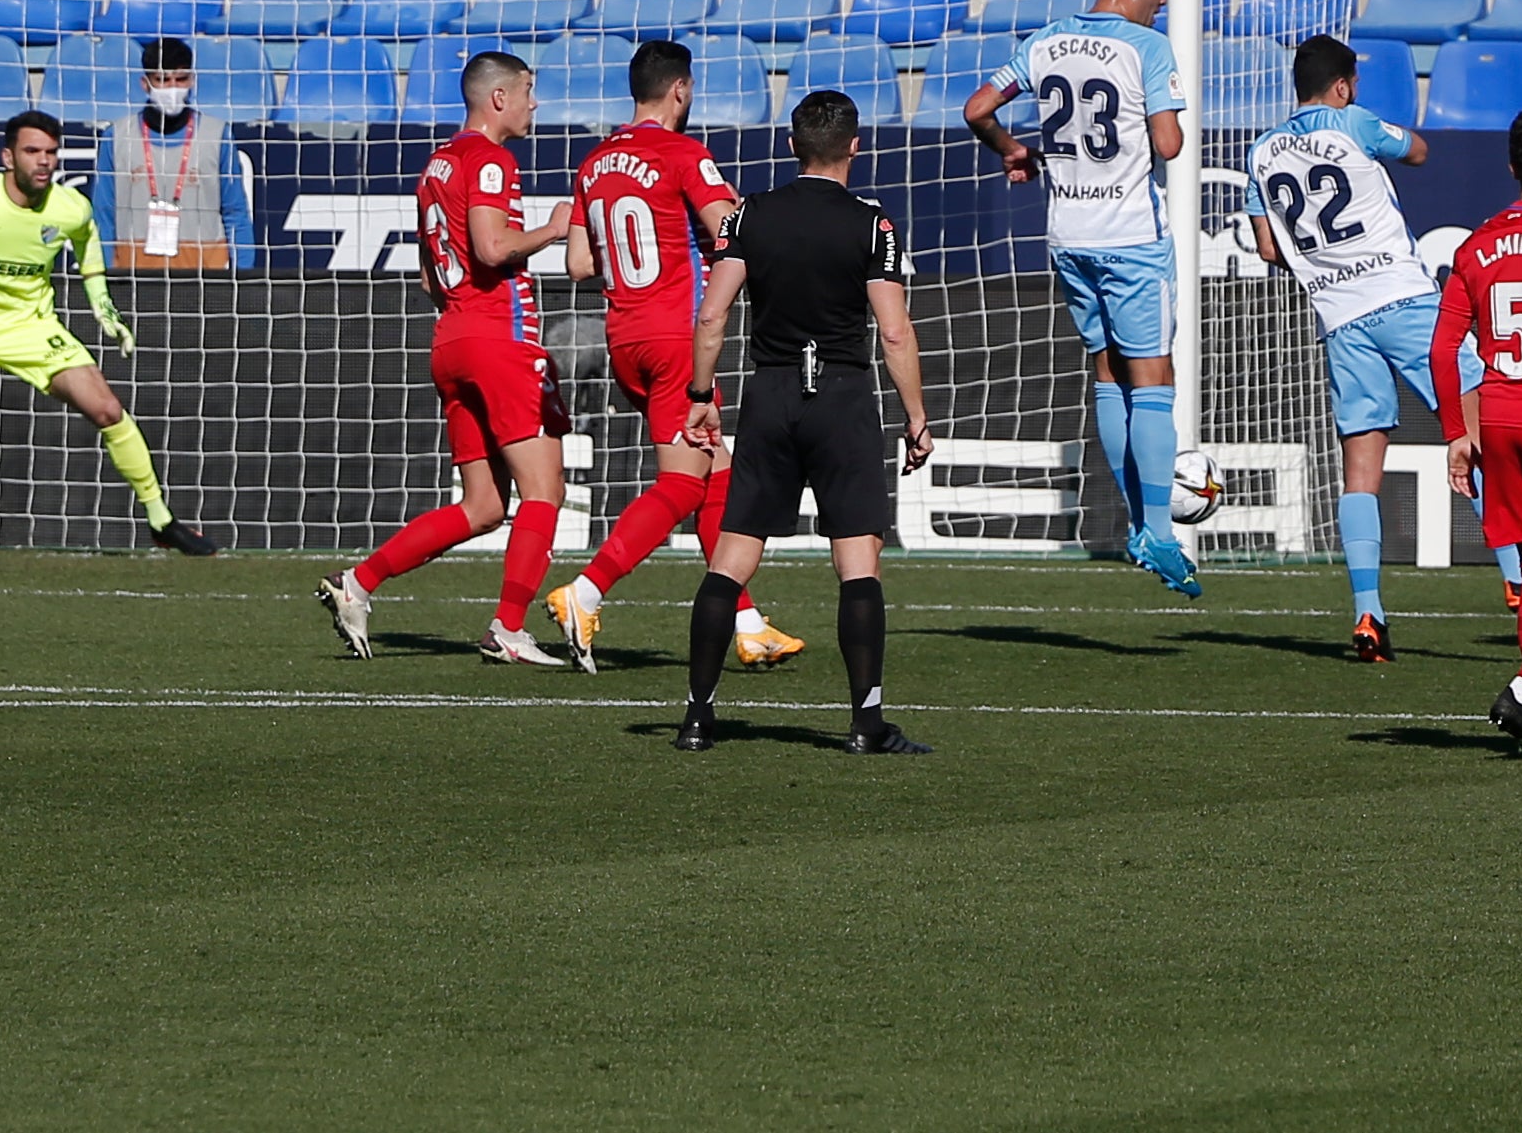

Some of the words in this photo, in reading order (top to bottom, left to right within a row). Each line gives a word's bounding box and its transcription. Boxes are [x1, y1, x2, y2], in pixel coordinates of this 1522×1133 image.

[1047, 37, 1119, 66] ESCASSI
[1038, 74, 1121, 163] 23
[1053, 184, 1124, 201] NAHAVIS
[1266, 163, 1367, 256] 22
[425, 201, 465, 290] 3
[588, 195, 662, 291] 10
[1102, 255, 1125, 264] SOL
[1306, 251, 1395, 296] BENAHAVIS
[668, 434, 1468, 567] EAT
